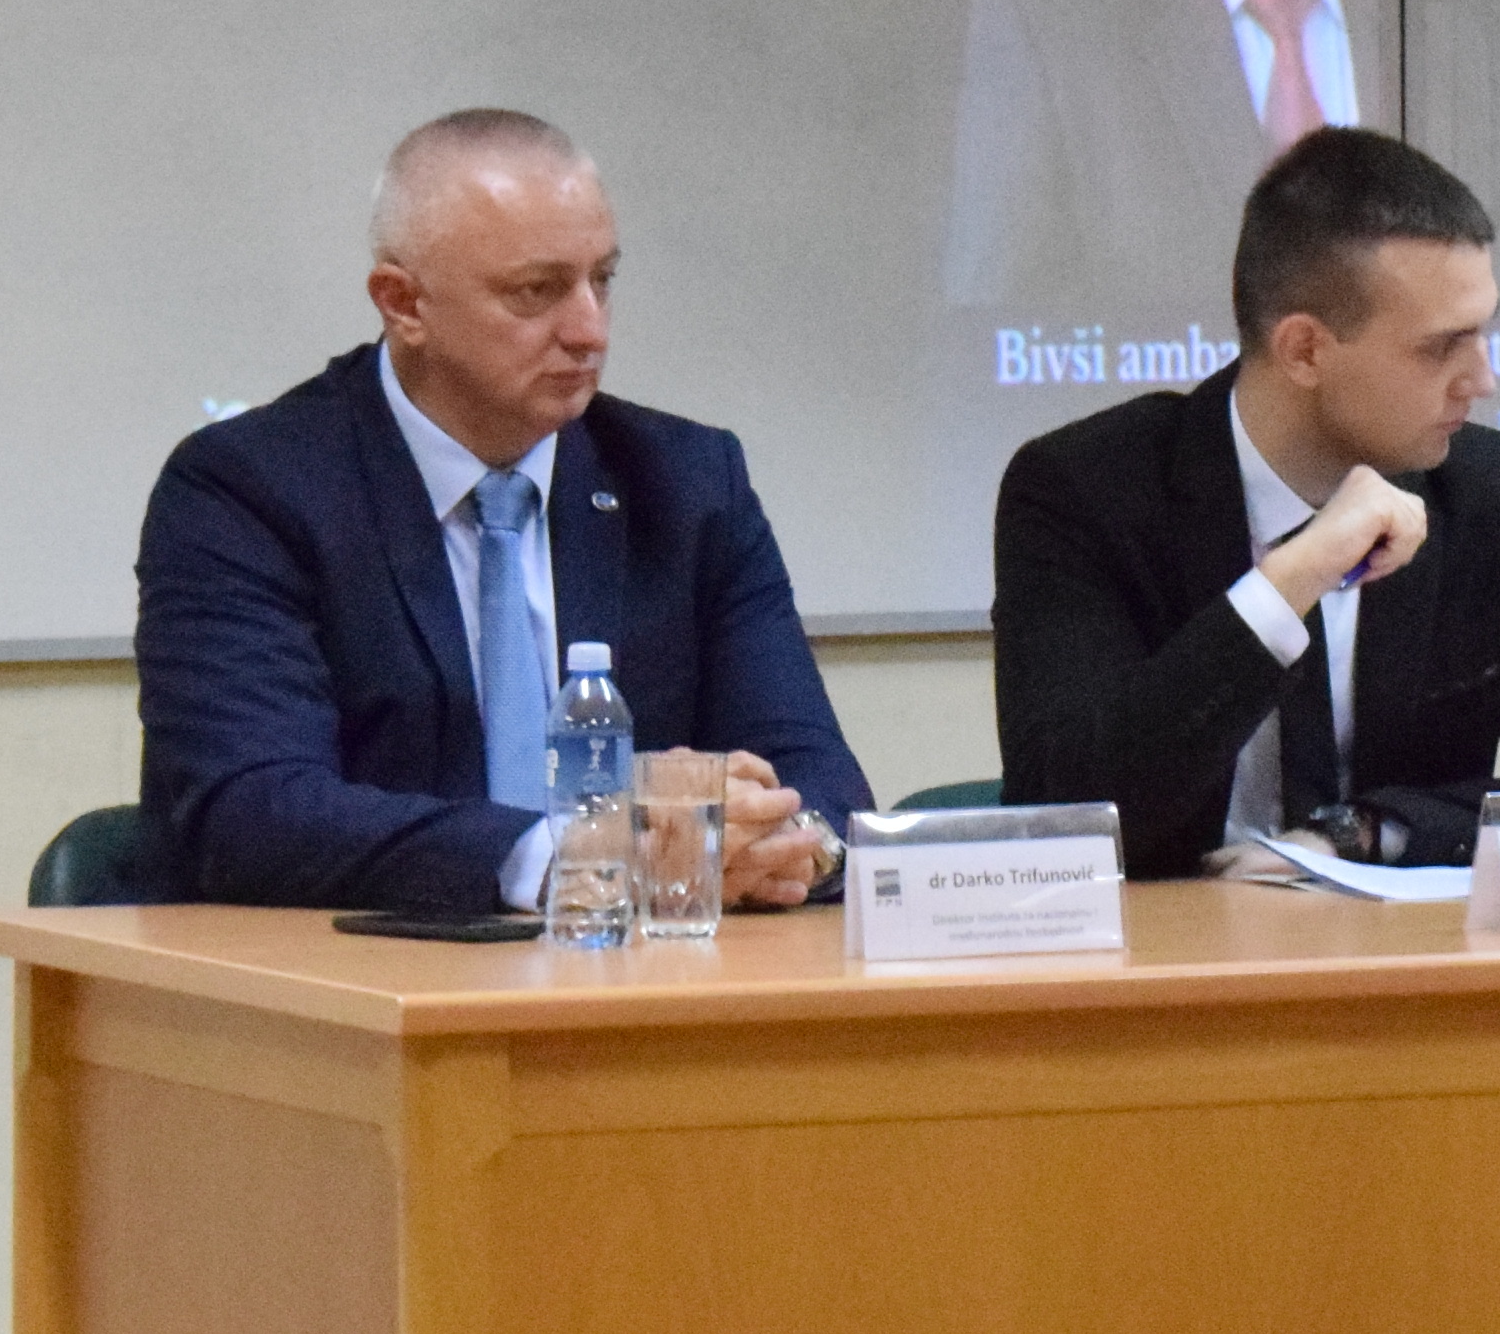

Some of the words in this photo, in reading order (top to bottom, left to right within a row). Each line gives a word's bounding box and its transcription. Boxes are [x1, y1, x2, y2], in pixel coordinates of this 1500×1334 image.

[996, 323, 1105, 385] Bivši
[1119, 323, 1239, 383] amba
[929, 872, 947, 890] dr
[953, 869, 1005, 889] Darko
[1009, 864, 1095, 886] Trifunović
